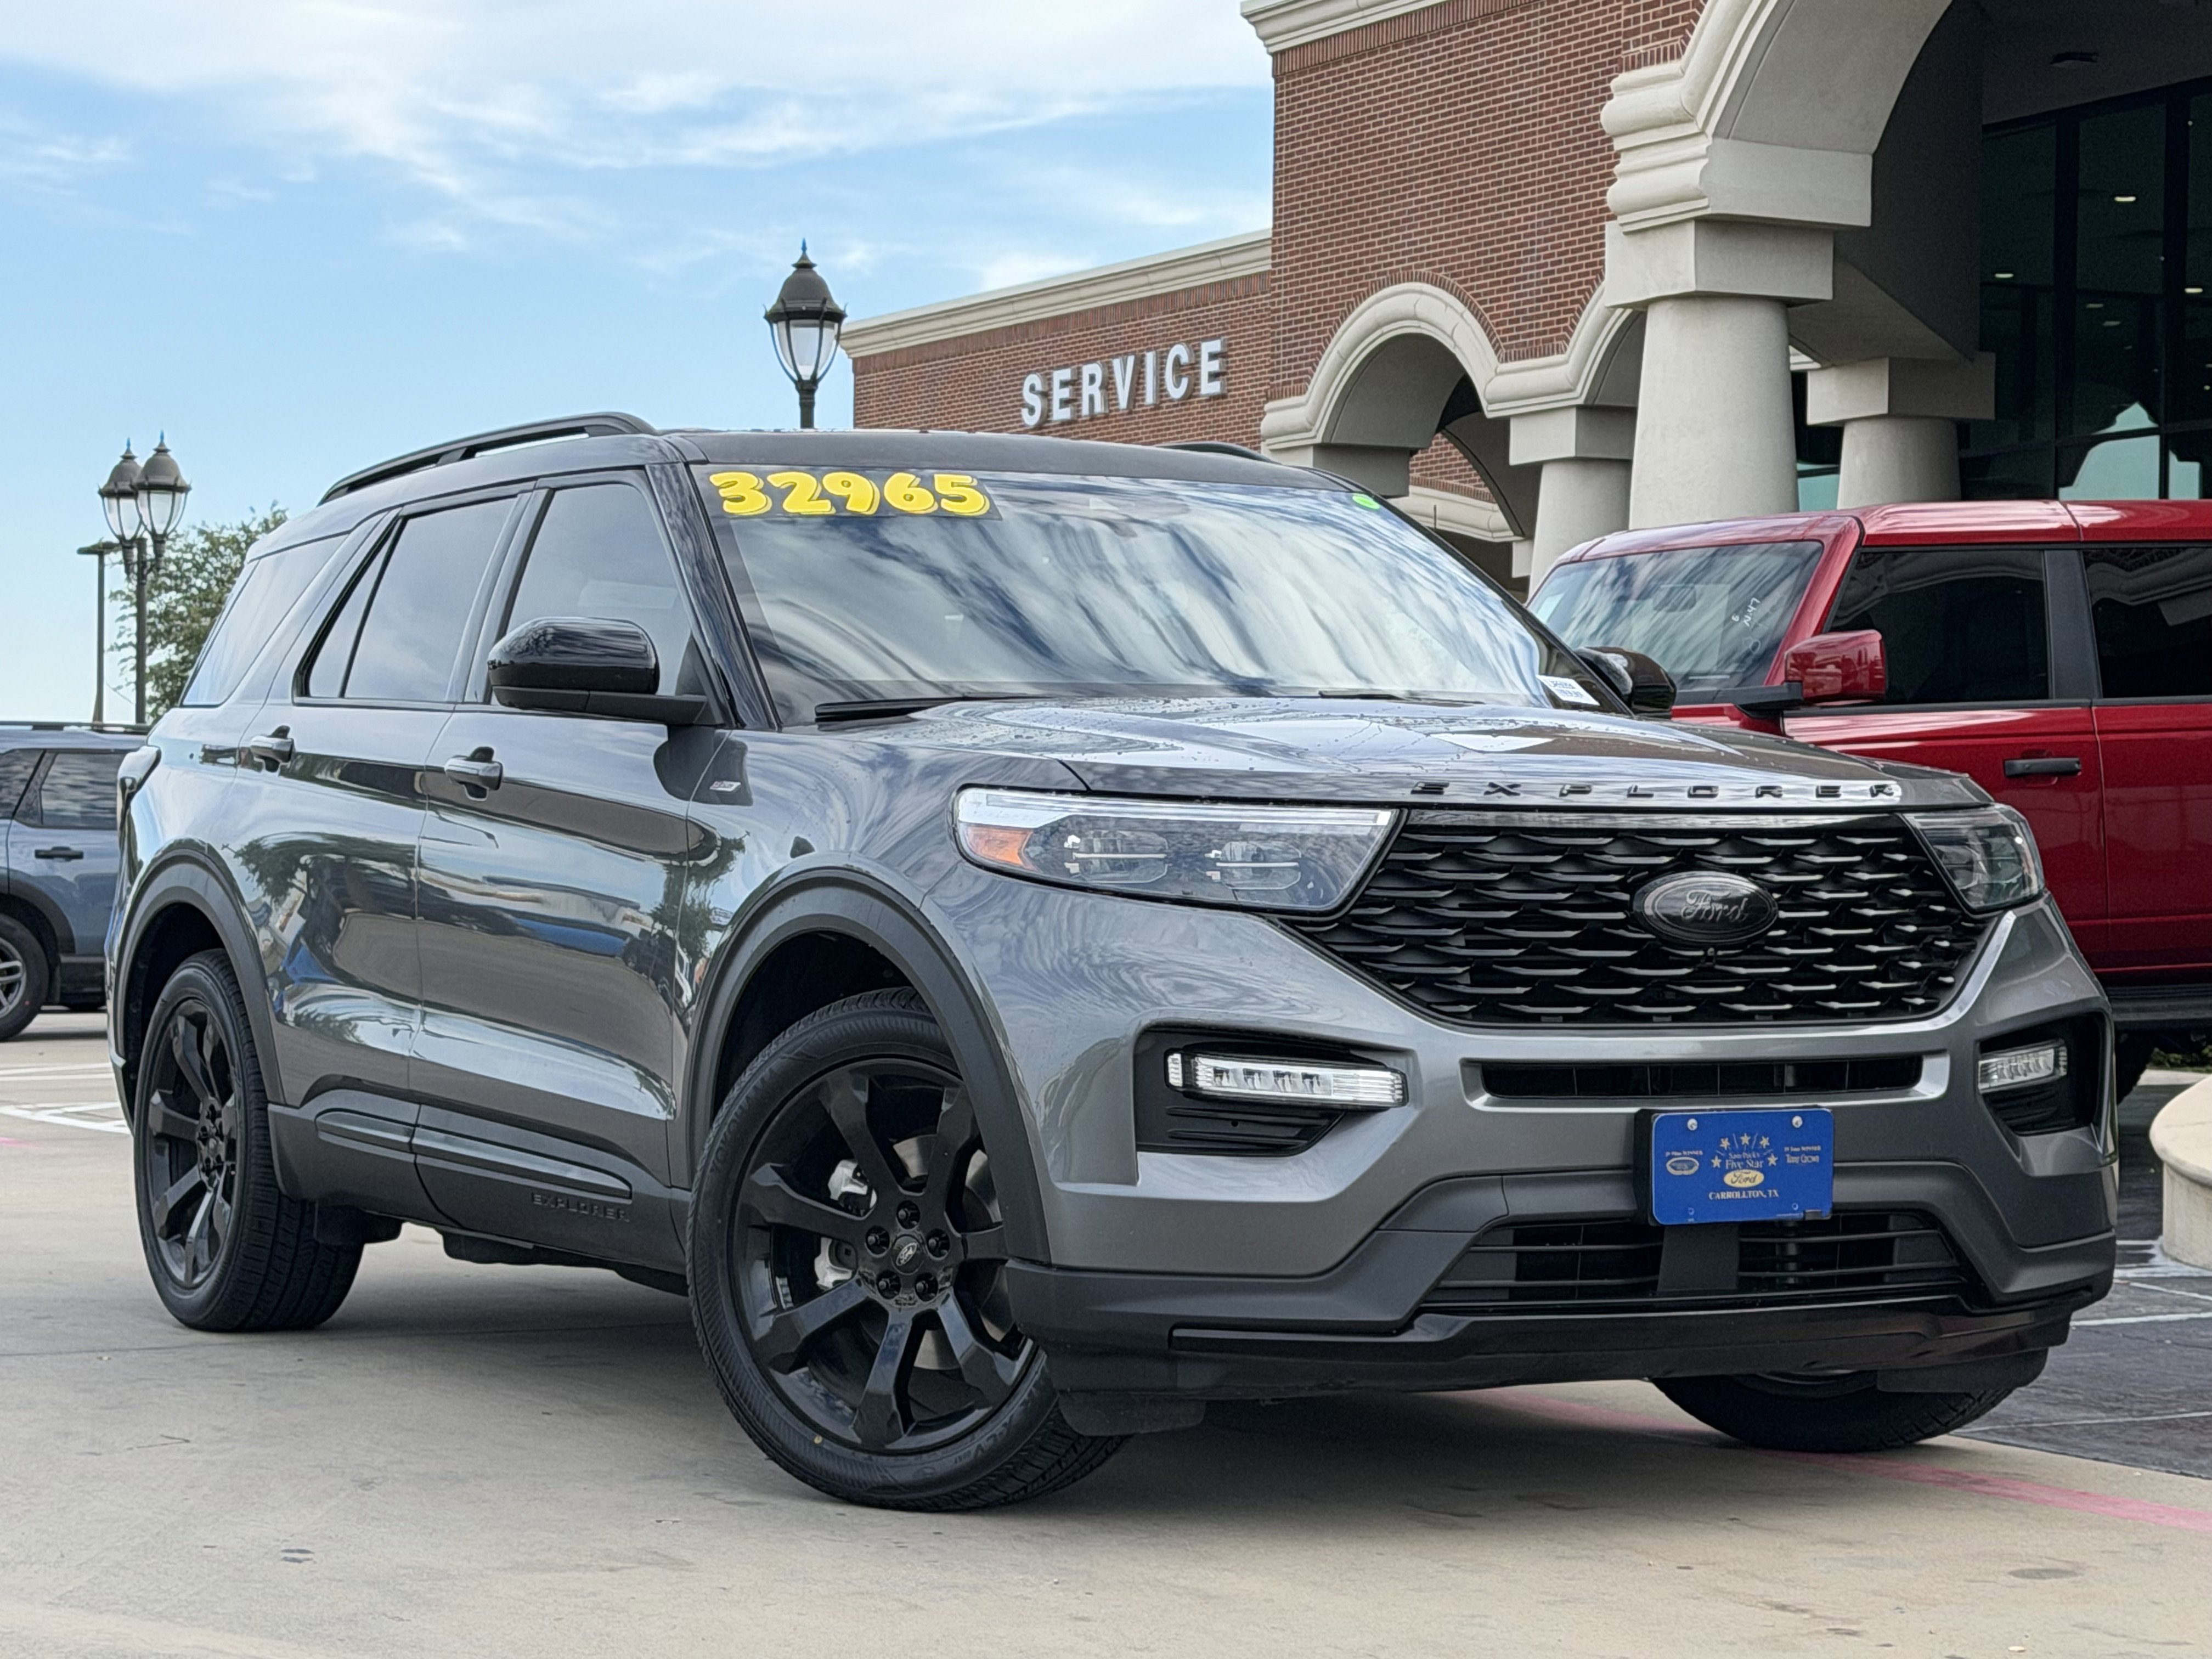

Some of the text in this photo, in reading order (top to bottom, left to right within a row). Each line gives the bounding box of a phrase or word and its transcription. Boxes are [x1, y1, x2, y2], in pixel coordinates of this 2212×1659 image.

[1020, 337, 1228, 428] SERVICE
[709, 471, 990, 516] 32965
[1410, 781, 1895, 799] EXPLORER
[1680, 889, 1750, 923] Ford
[1725, 1159, 1764, 1170] Five Star
[1731, 1171, 1758, 1184] Ford
[1767, 1189, 1779, 1198] TX
[531, 1192, 630, 1223] EXPLORER
